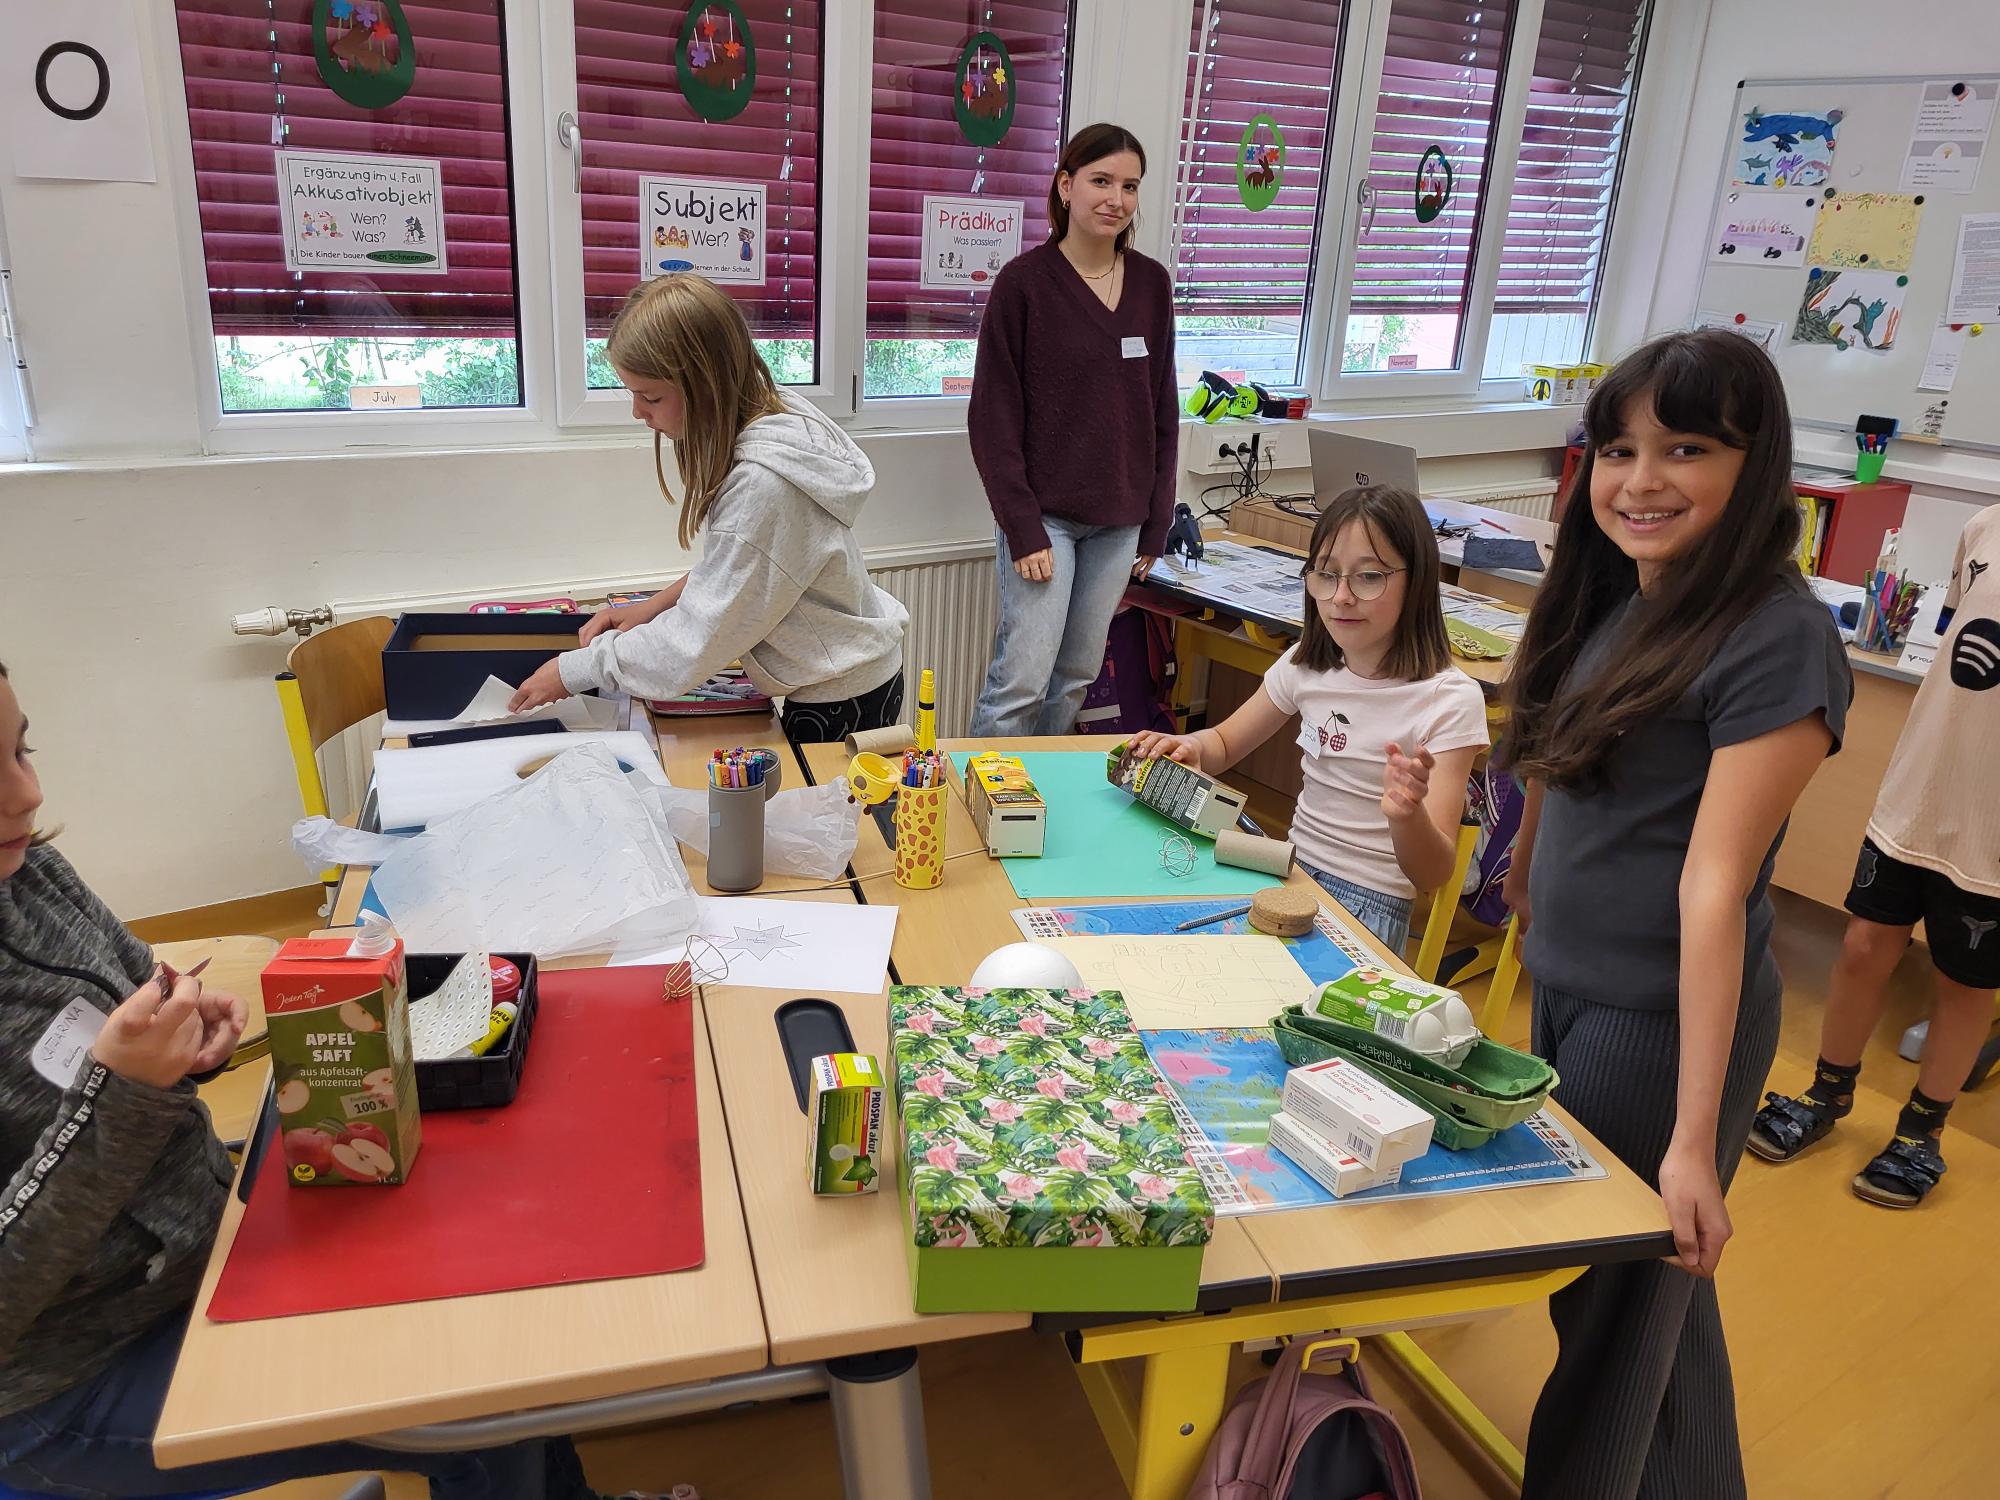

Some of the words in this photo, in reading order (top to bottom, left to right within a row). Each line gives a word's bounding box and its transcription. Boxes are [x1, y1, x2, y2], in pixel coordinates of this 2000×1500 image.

[303, 167, 371, 183] Ergänzung
[373, 170, 387, 181] im
[401, 172, 422, 184] Fall
[293, 184, 433, 206] Akkusativobjekt
[654, 190, 758, 224] Subjekt
[350, 213, 387, 226] Wen?
[939, 209, 1014, 233] Prädikat
[351, 230, 387, 243] Was?
[691, 230, 729, 247] Wer?
[953, 236, 969, 245] Was
[970, 237, 1002, 247] passiert?
[300, 250, 313, 258] Die
[316, 250, 341, 259] Kinder
[343, 251, 366, 259] bauen
[721, 264, 731, 272] der
[372, 391, 397, 404] July
[1355, 472, 1370, 486] hp
[276, 991, 303, 1009] Jeden
[303, 988, 318, 1004] Tag
[305, 1032, 357, 1046] APFEL
[312, 1049, 352, 1062] SAFT
[300, 1068, 318, 1076] aus
[319, 1066, 368, 1078] Apfelsaft-
[308, 1078, 362, 1088] konzentrat
[353, 1101, 377, 1114] 100
[869, 1091, 881, 1130] PROSPAN
[867, 1131, 880, 1154] akut
